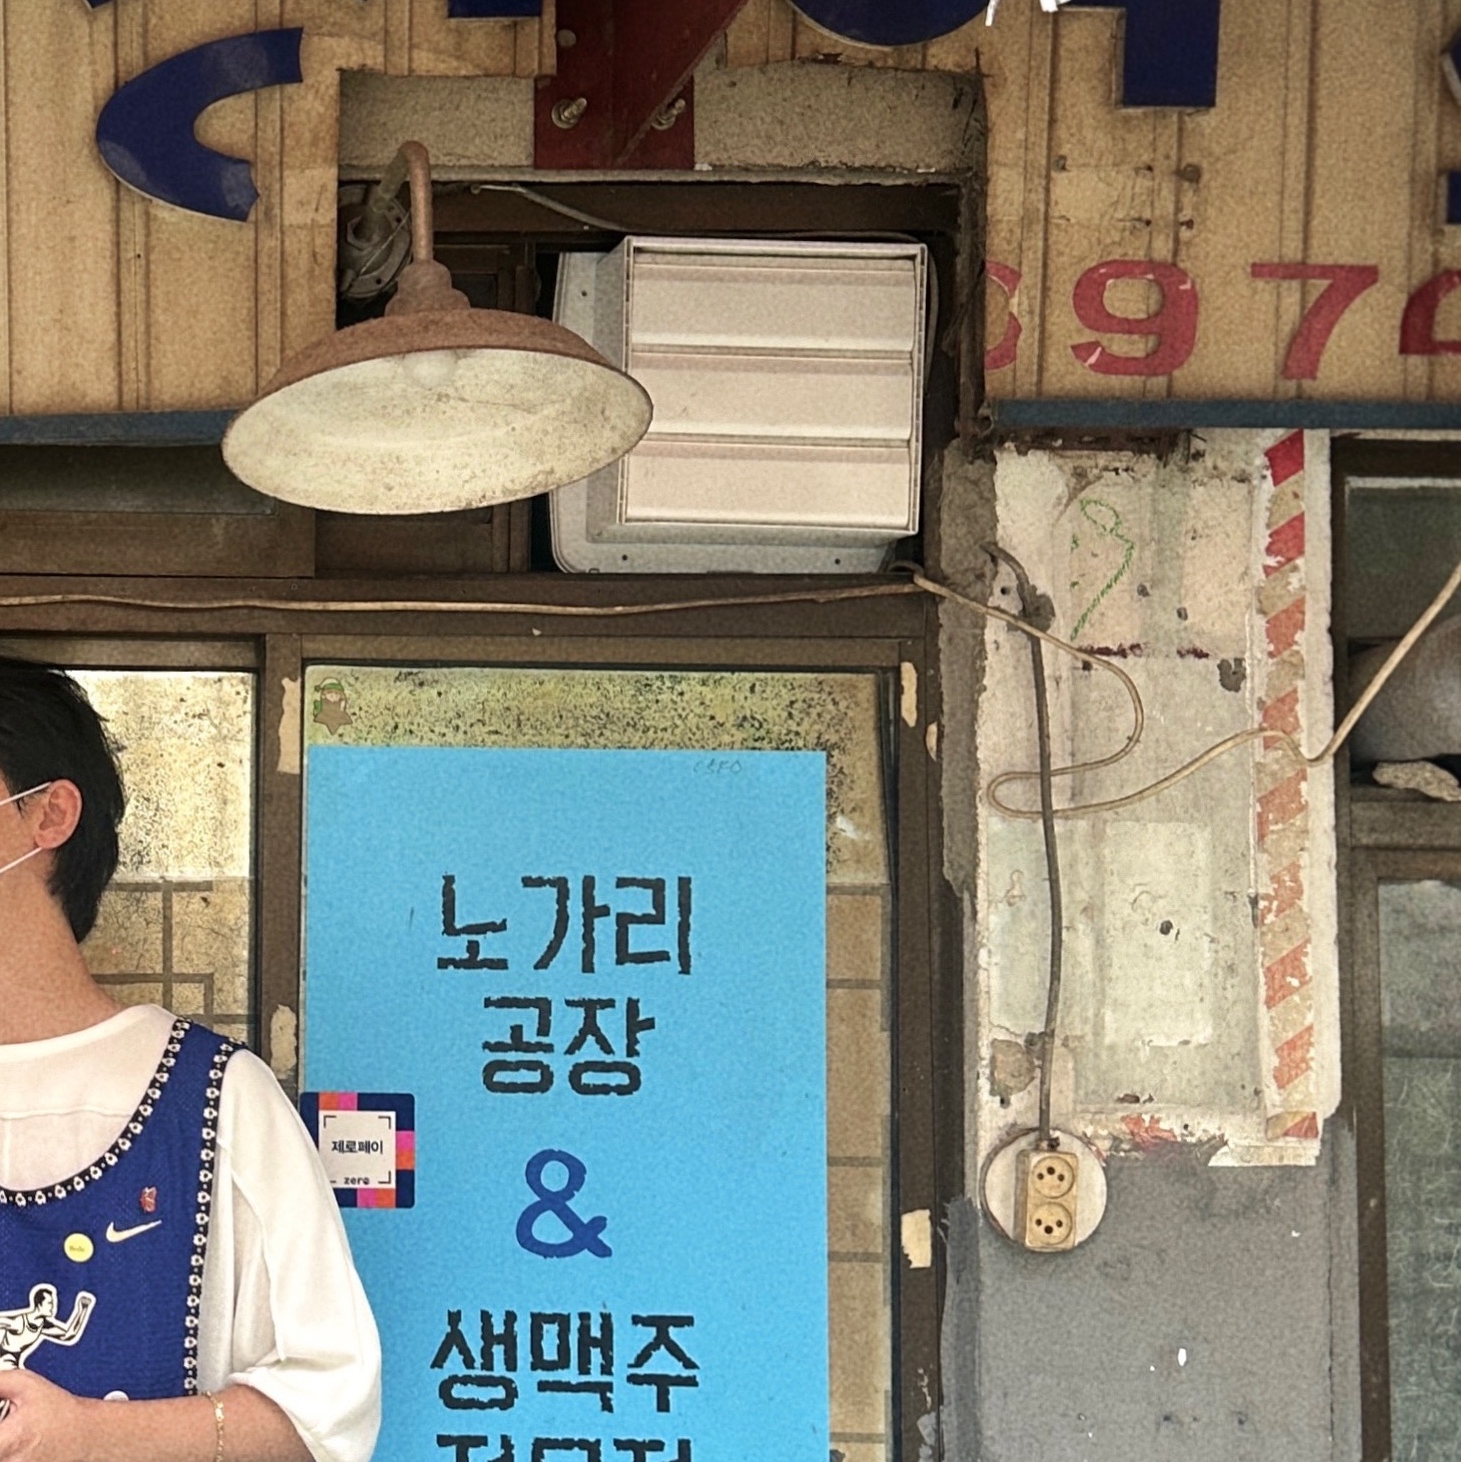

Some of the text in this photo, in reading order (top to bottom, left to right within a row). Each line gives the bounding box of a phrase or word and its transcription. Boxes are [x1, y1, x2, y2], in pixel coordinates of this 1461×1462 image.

[437, 874, 692, 976] 노가리
[481, 995, 656, 1096] 공장
[331, 1139, 383, 1154] 제로페이
[343, 1176, 371, 1185] zero
[515, 1148, 613, 1260] &
[430, 1308, 700, 1415] 생맥주
